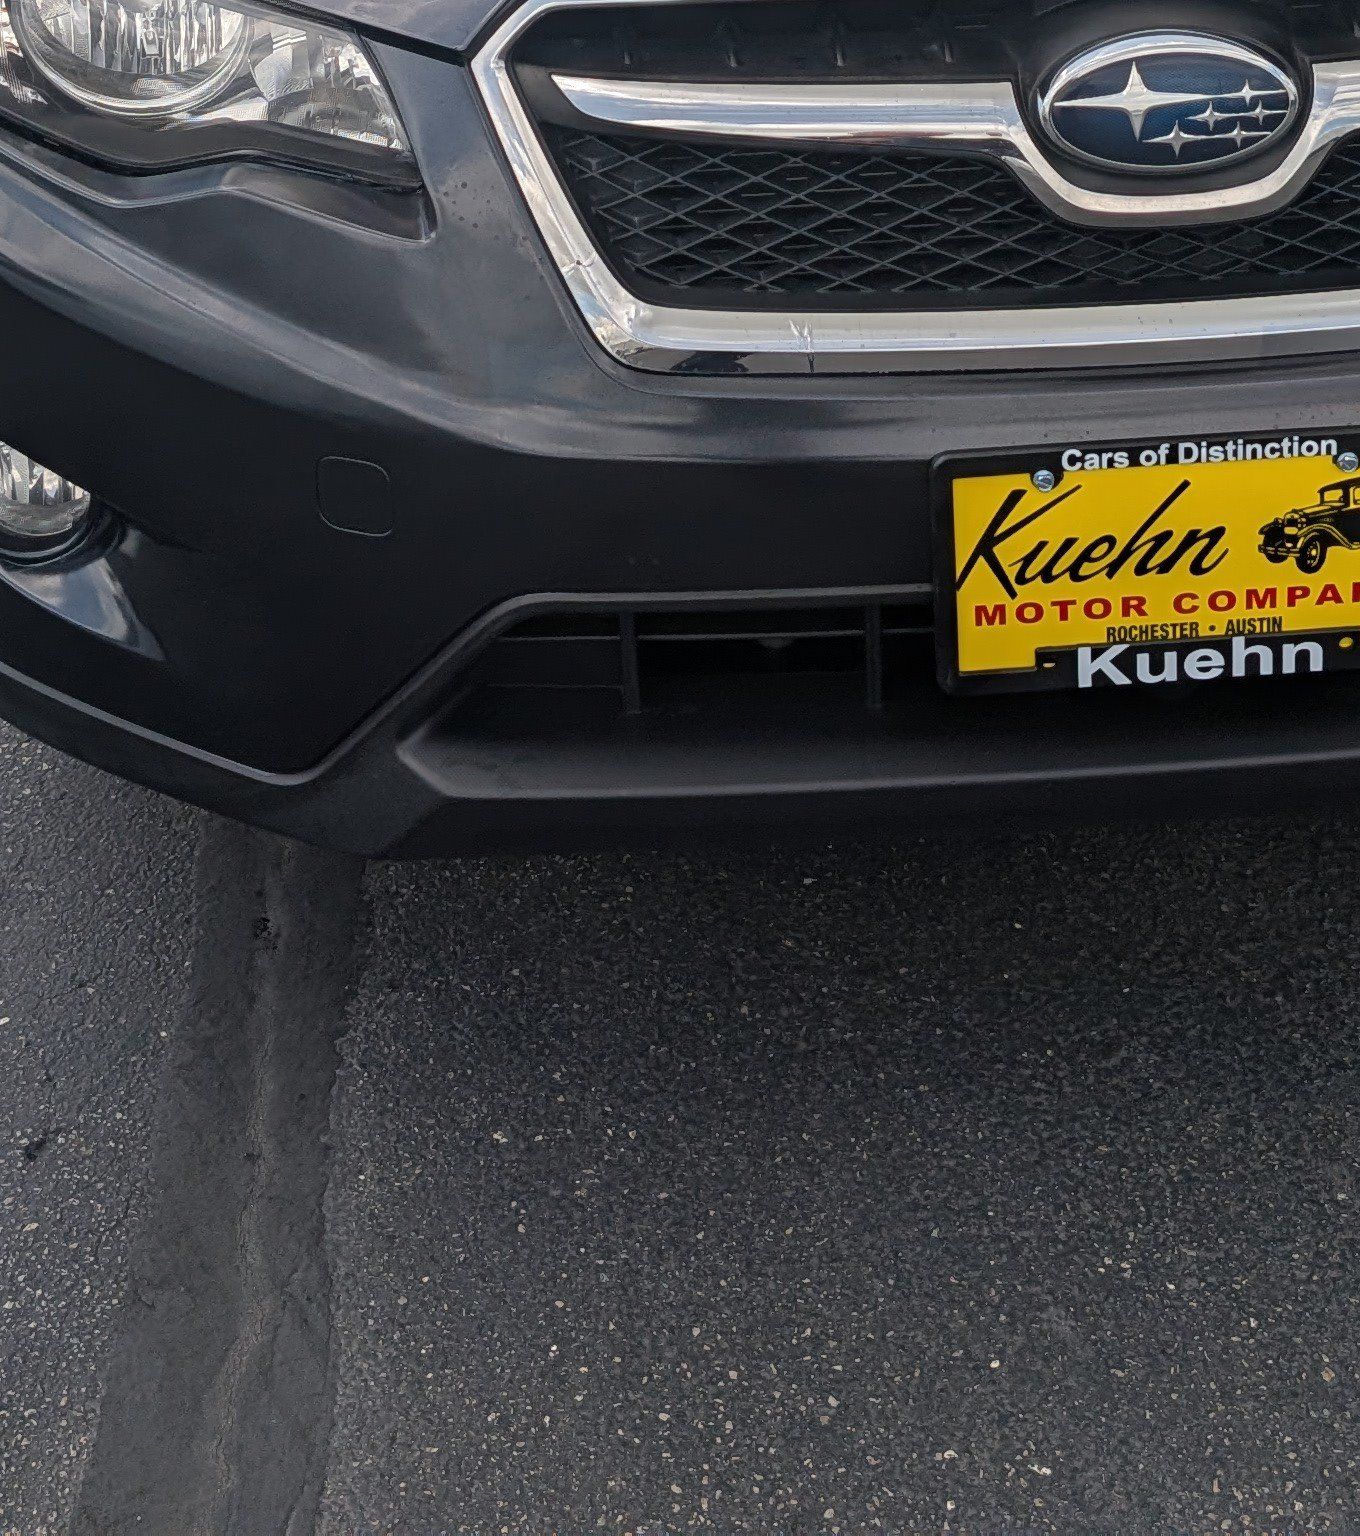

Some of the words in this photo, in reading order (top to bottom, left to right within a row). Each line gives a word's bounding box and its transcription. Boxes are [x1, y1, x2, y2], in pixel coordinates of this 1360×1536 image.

[1061, 448, 1130, 472] Cars
[1139, 443, 1170, 467] of
[1178, 435, 1338, 464] Distinction
[956, 479, 1229, 600] Kuehn
[974, 595, 1149, 627] MOTOR
[1106, 621, 1200, 643] ROCHESTER
[1224, 615, 1283, 637] AUSTIN
[1077, 636, 1324, 689] Kuehn
